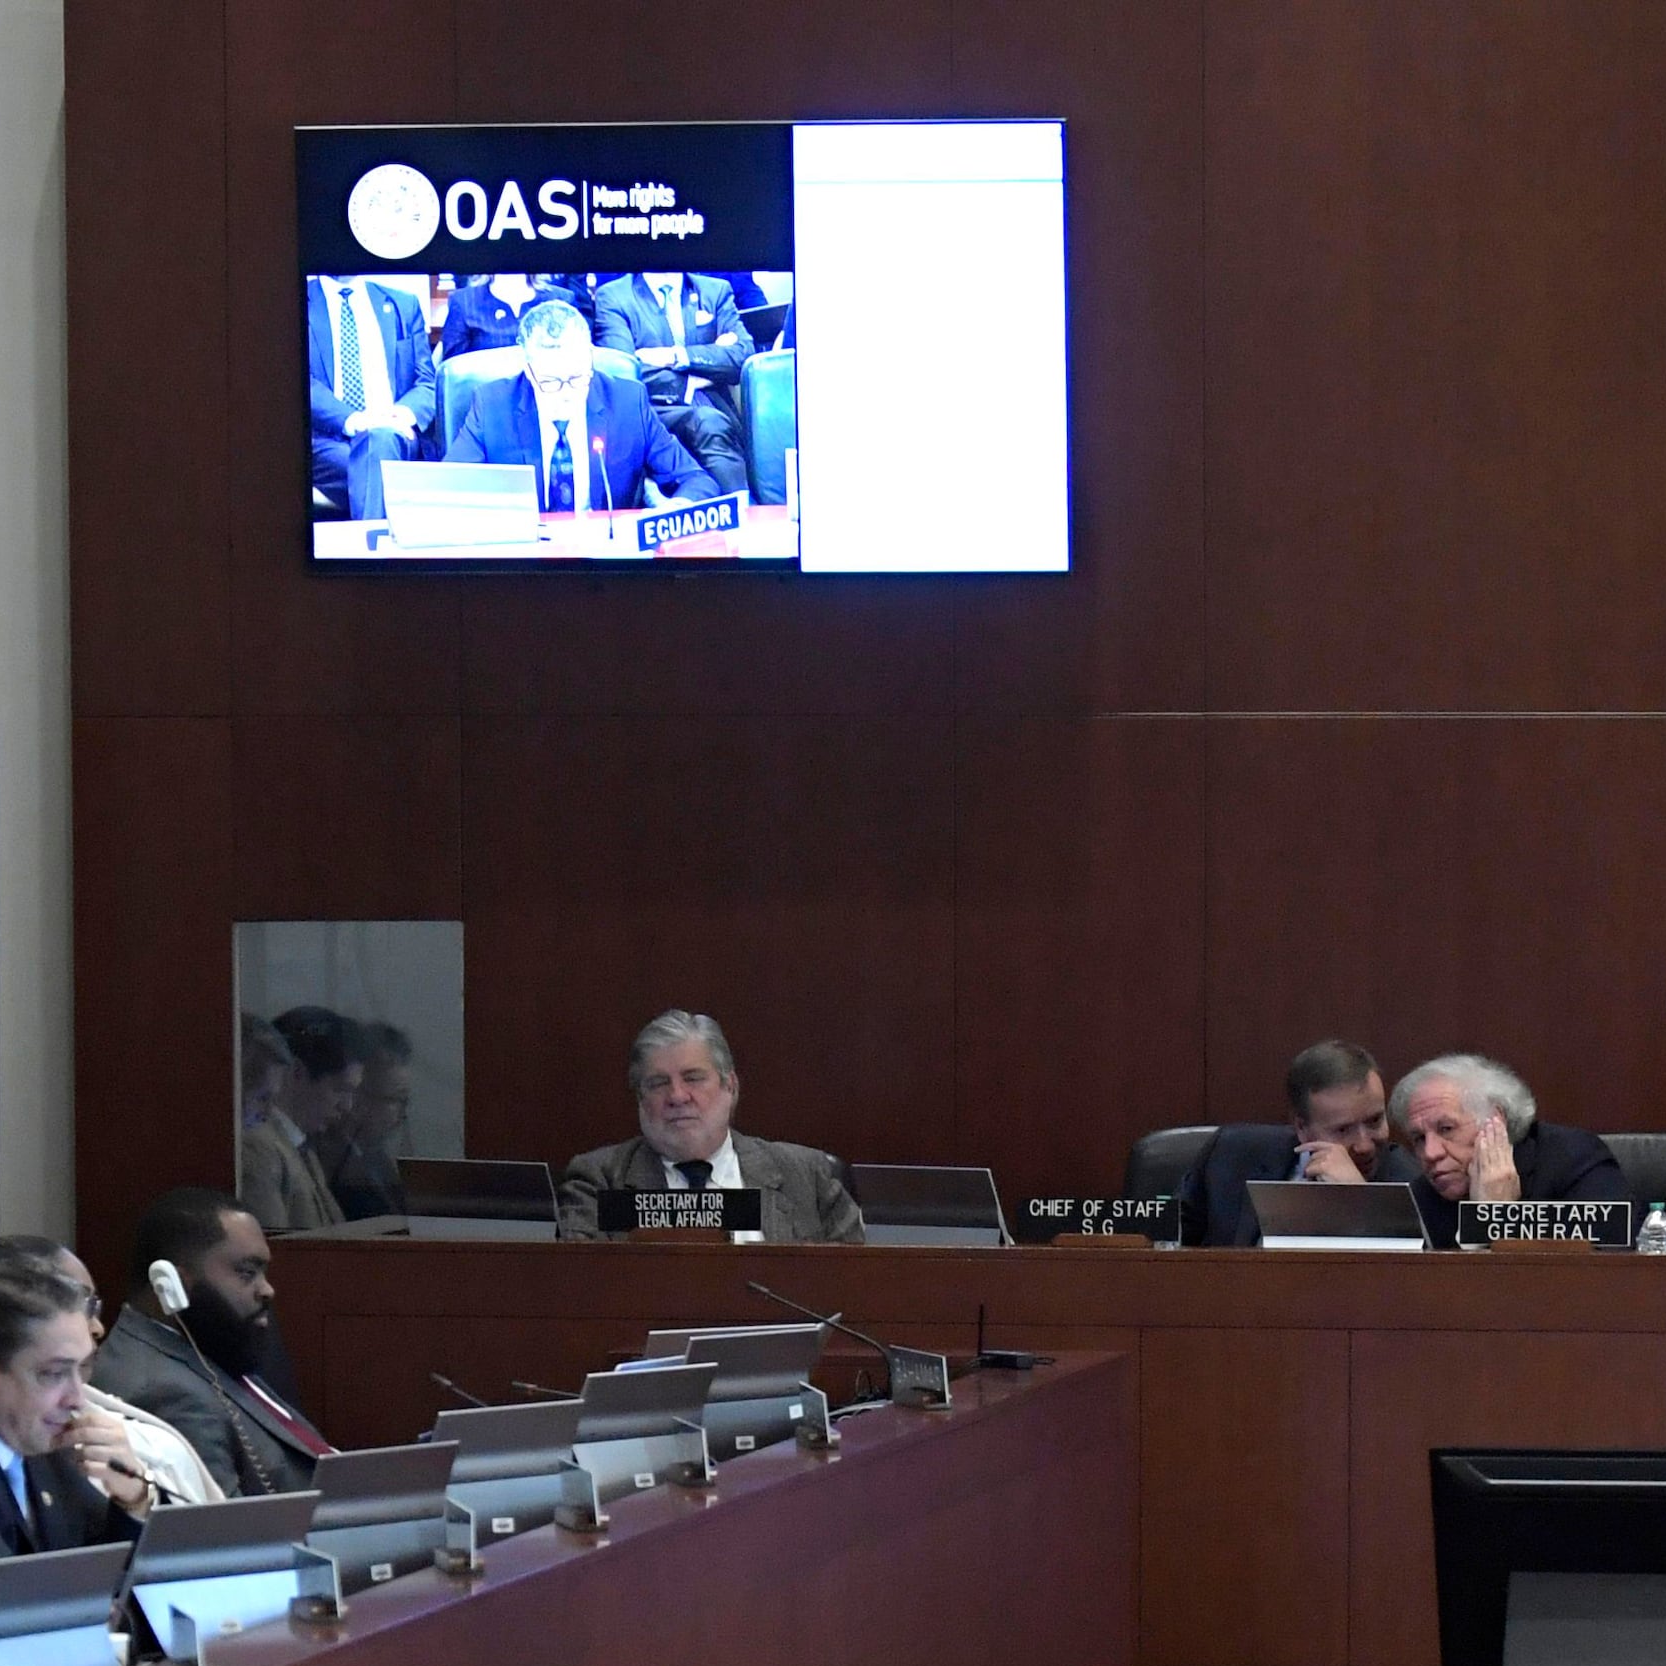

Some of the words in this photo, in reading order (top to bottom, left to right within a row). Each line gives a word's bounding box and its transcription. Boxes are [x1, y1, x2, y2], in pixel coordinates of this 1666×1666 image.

[592, 184, 628, 208] More
[629, 182, 676, 213] rights
[444, 178, 580, 241] OAS
[592, 212, 613, 235] for
[614, 216, 650, 235] more
[651, 208, 704, 240] people
[644, 502, 733, 546] ECUADOR
[634, 1193, 698, 1210] SECRETARY
[701, 1193, 724, 1210] FOR
[1029, 1199, 1075, 1217] CHIEF
[1082, 1200, 1104, 1217] OF
[1112, 1200, 1167, 1217] STAFF
[638, 1211, 672, 1229] LEGAL
[674, 1210, 722, 1228] AFFAIRS
[1476, 1203, 1612, 1223] SECRETARY
[1486, 1222, 1602, 1242] GENERAL
